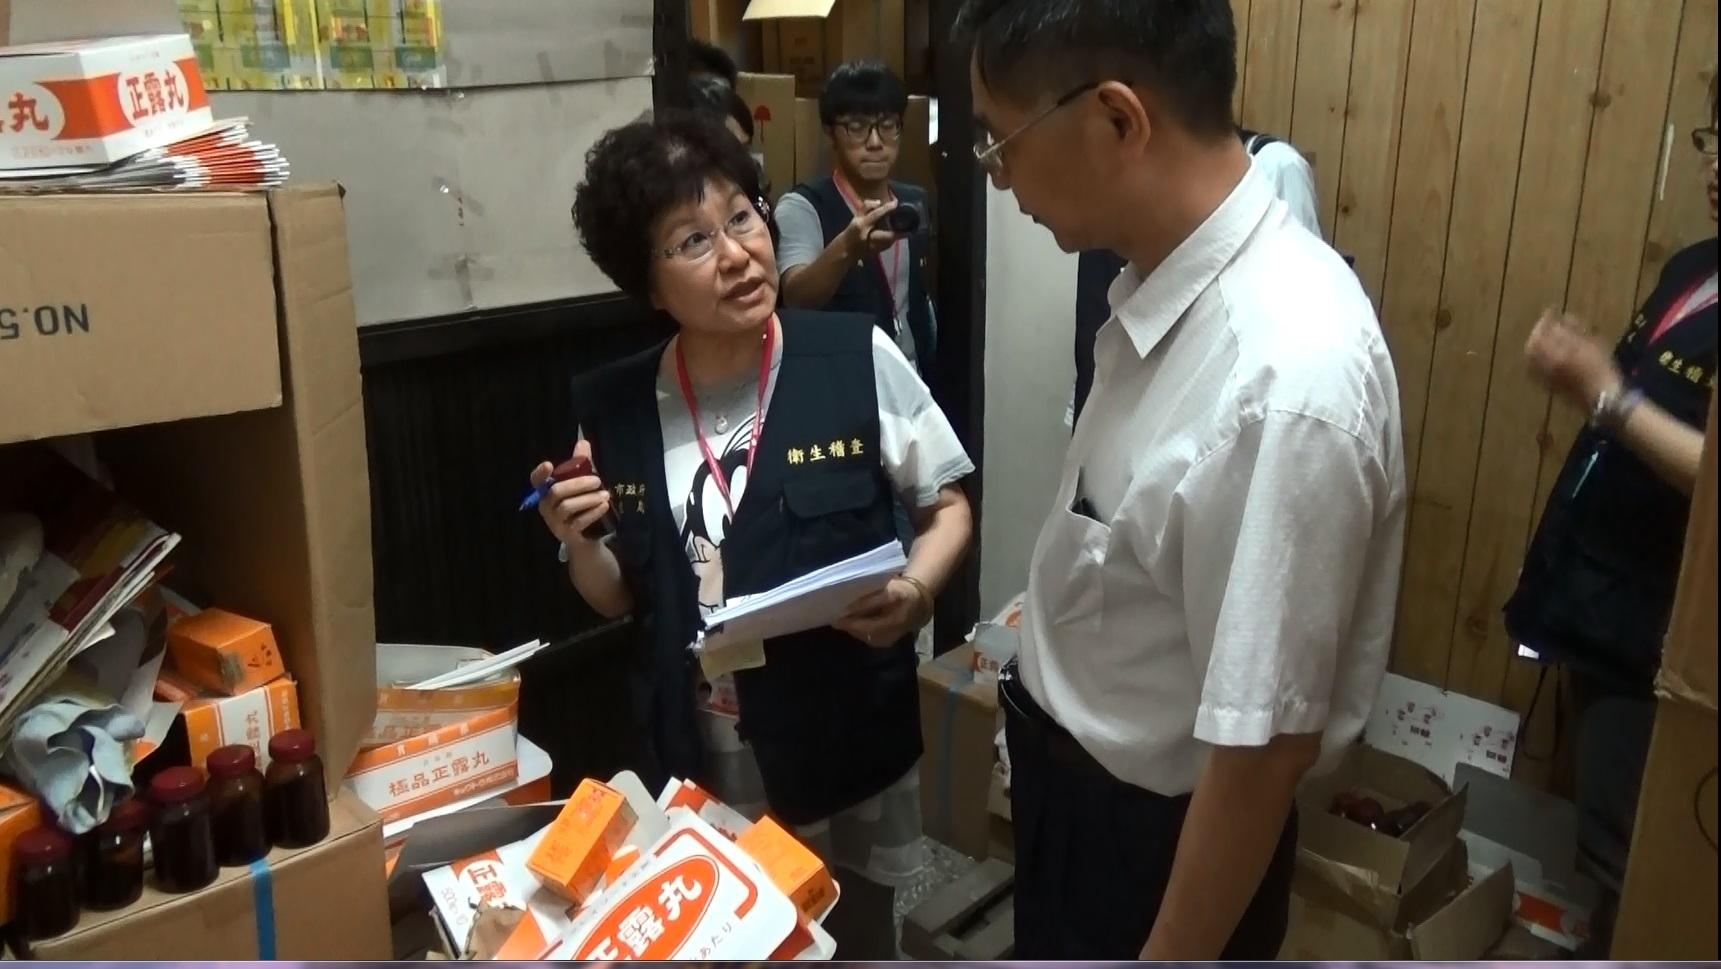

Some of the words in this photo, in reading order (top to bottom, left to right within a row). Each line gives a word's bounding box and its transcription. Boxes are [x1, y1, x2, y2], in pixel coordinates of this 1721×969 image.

[0, 91, 49, 132] 丸
[126, 69, 185, 120] 正露丸
[787, 438, 864, 464] 衛生稽查
[388, 750, 490, 797] 極品正露丸
[689, 921, 732, 960] あたり
